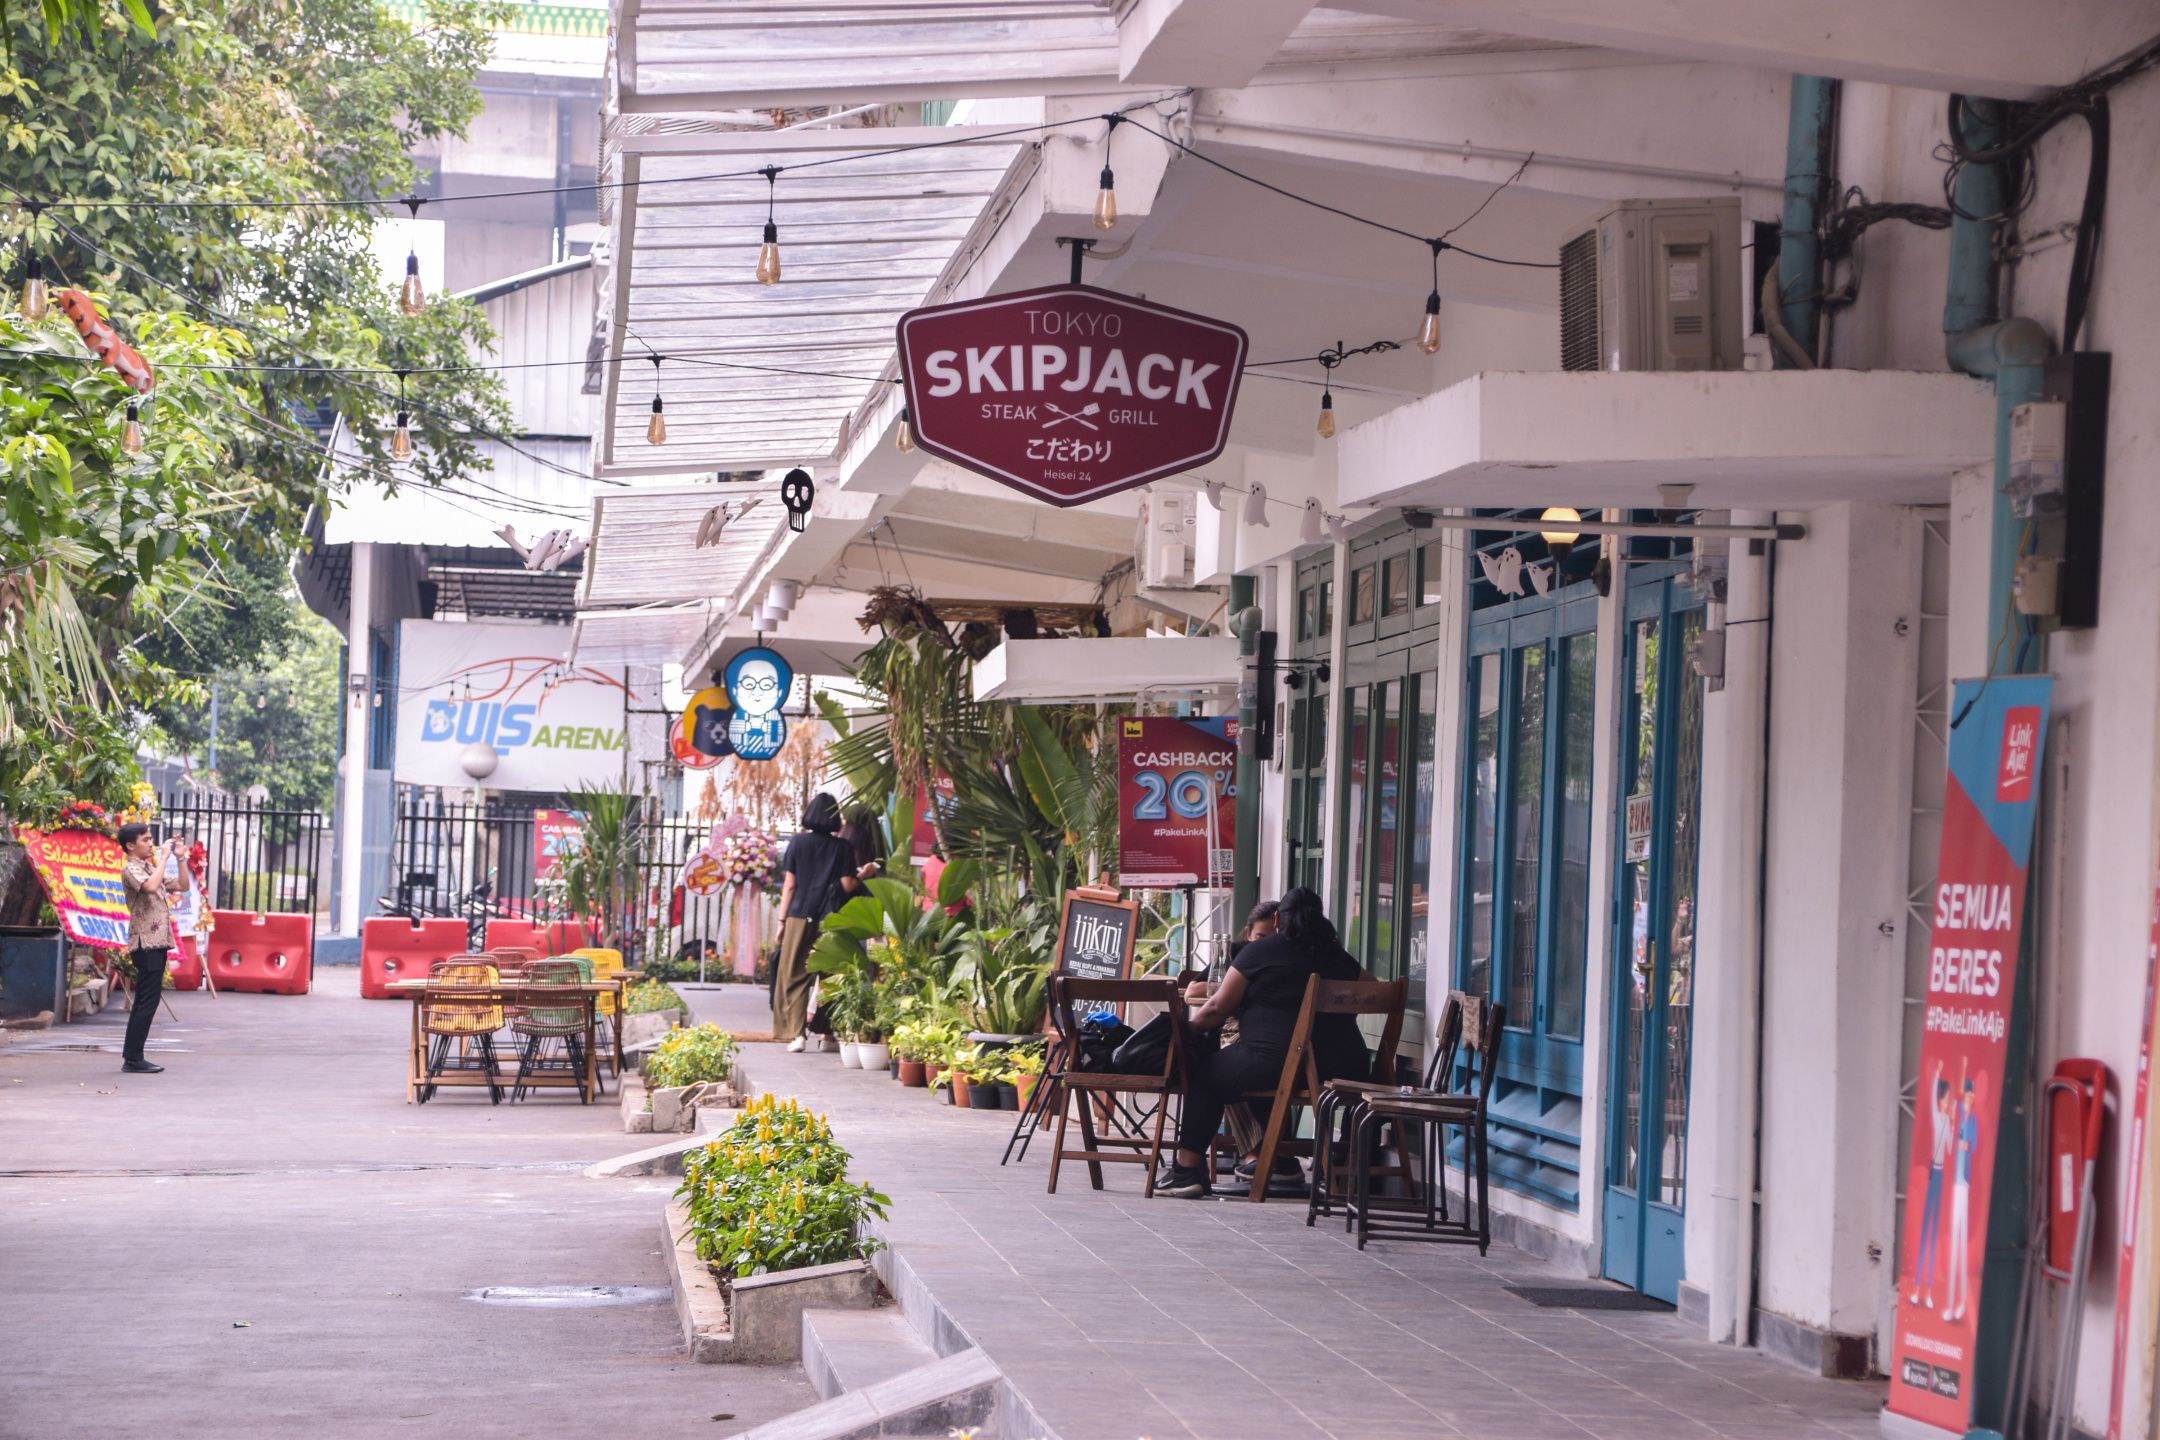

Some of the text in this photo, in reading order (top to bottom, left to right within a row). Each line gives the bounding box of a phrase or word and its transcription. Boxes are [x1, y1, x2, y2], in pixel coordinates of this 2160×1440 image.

[1024, 310, 1122, 338] TOKYO
[925, 344, 1221, 410] SKIPJACK
[981, 404, 1159, 426] STEAK GRILL
[1025, 437, 1112, 463] こだわり
[1043, 468, 1092, 482] Heisei 24
[531, 725, 632, 752] ARENA
[2009, 723, 2032, 748] Link
[1133, 752, 1234, 766] CASHBACK
[2006, 747, 2029, 774] Aja!
[1133, 769, 1237, 820] 20%
[1629, 800, 1651, 833] BUKA
[1153, 828, 1208, 838] #PakeLinkAj
[1936, 883, 2012, 932] SEMUA
[78, 915, 119, 942] GABBY
[1073, 914, 1123, 955] tjikini
[1929, 947, 2003, 998] BERES
[1927, 1007, 2005, 1043] #PakeLinkAja
